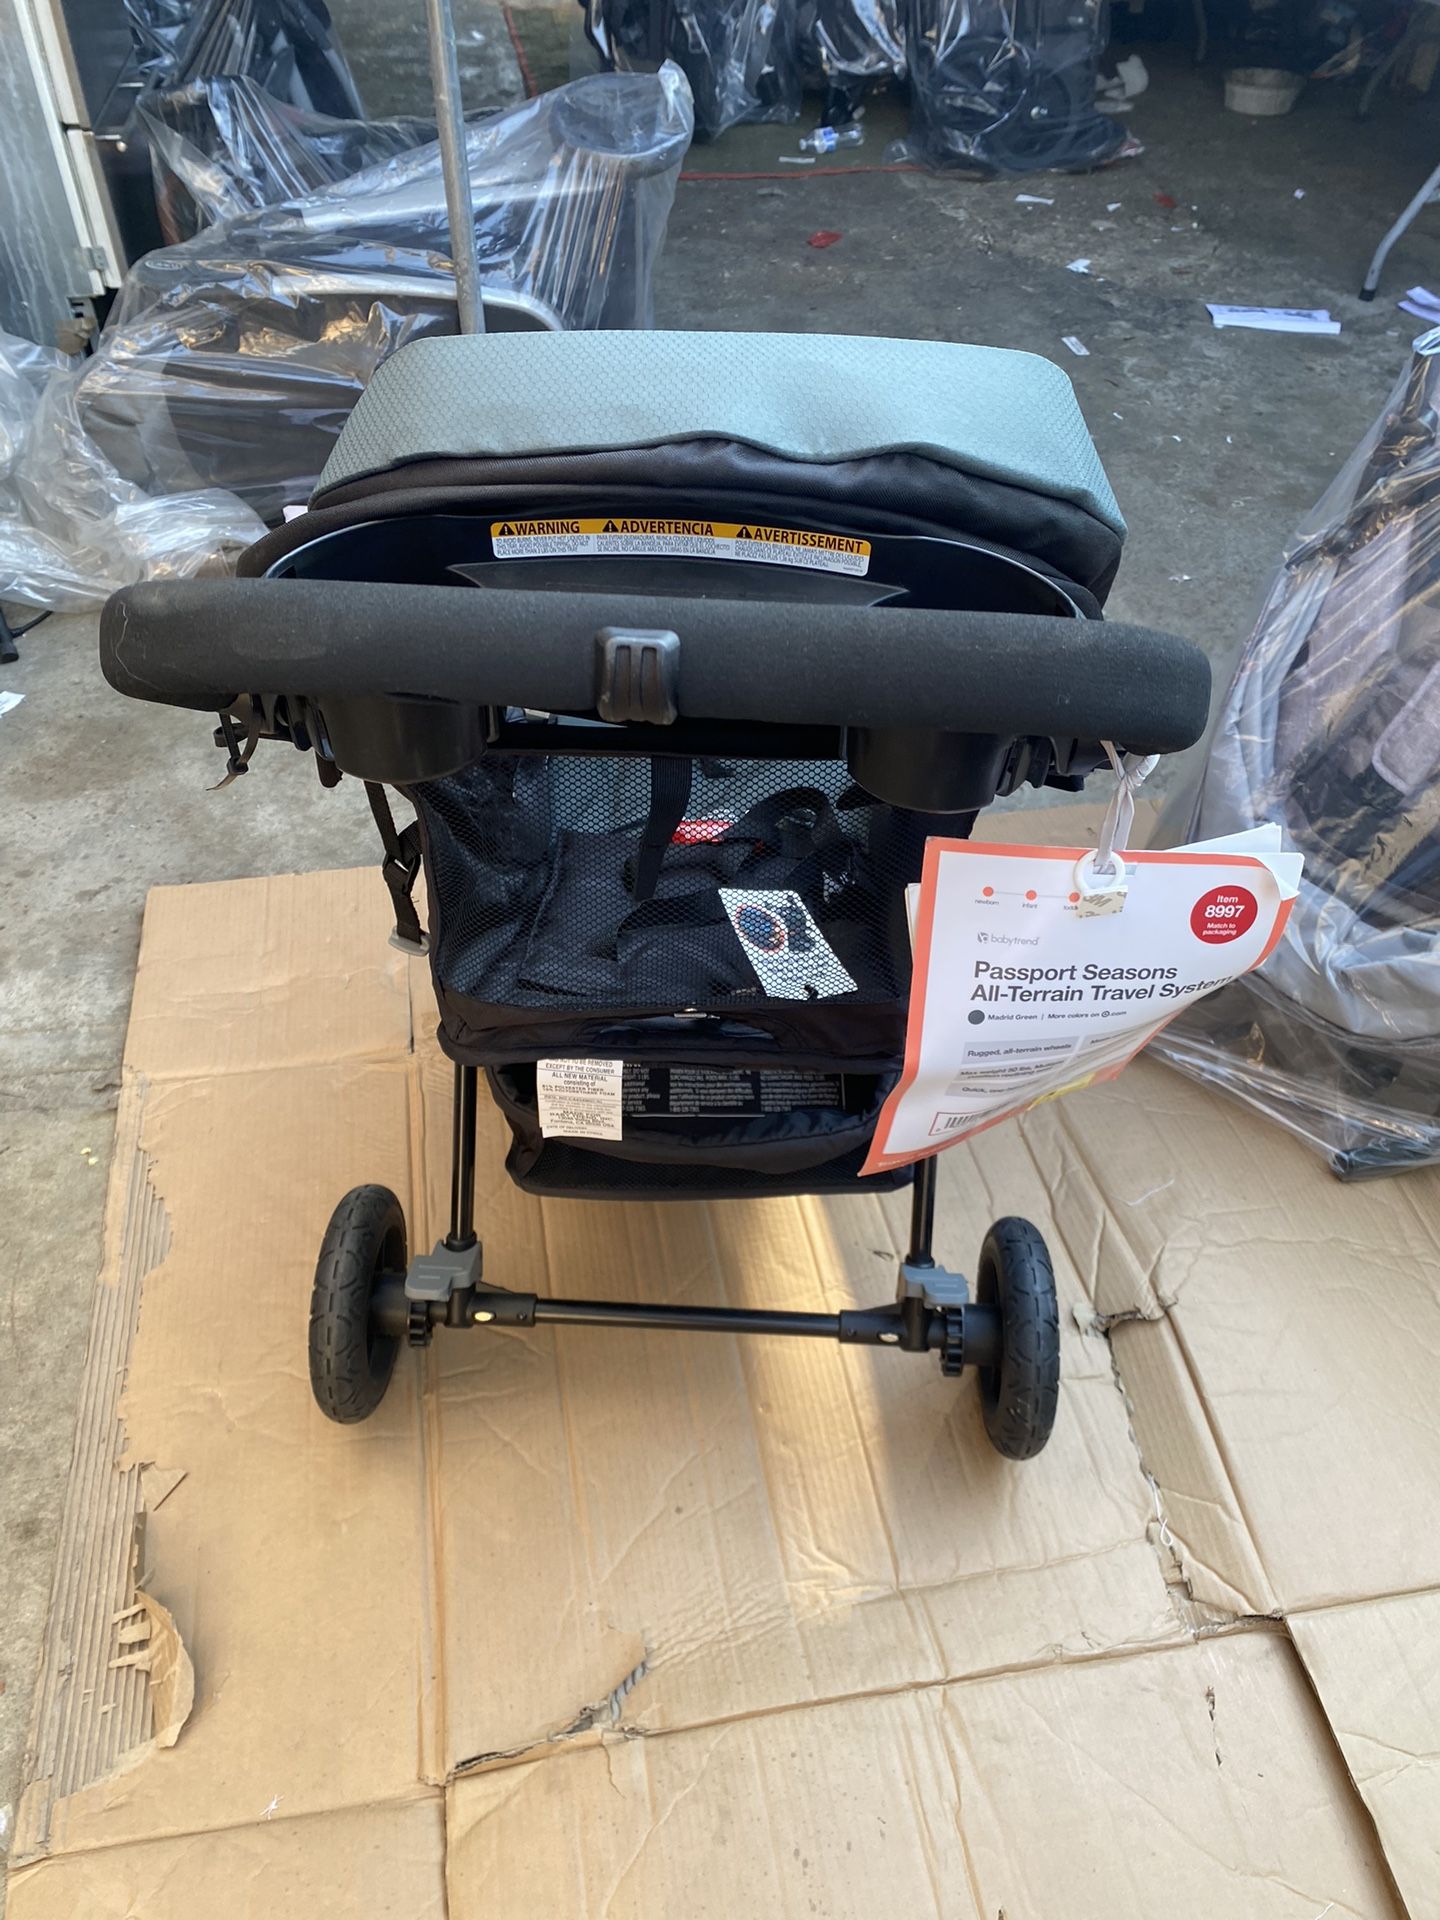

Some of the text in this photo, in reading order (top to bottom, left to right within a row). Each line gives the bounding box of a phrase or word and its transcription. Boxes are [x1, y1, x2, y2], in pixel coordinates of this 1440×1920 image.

[514, 521, 580, 535] WARNING
[620, 520, 714, 536] ADVERTENCIA
[754, 528, 863, 554] AVERTISSEMENT
[1217, 895, 1238, 903] Item
[1204, 904, 1245, 918] 8997
[990, 934, 1038, 946] babytrend
[974, 960, 1178, 984] Passport Seasons
[970, 976, 1233, 1002] All-Terrain Travel System
[586, 1066, 614, 1074] CONSUMER
[579, 1074, 607, 1082] MATERIAL
